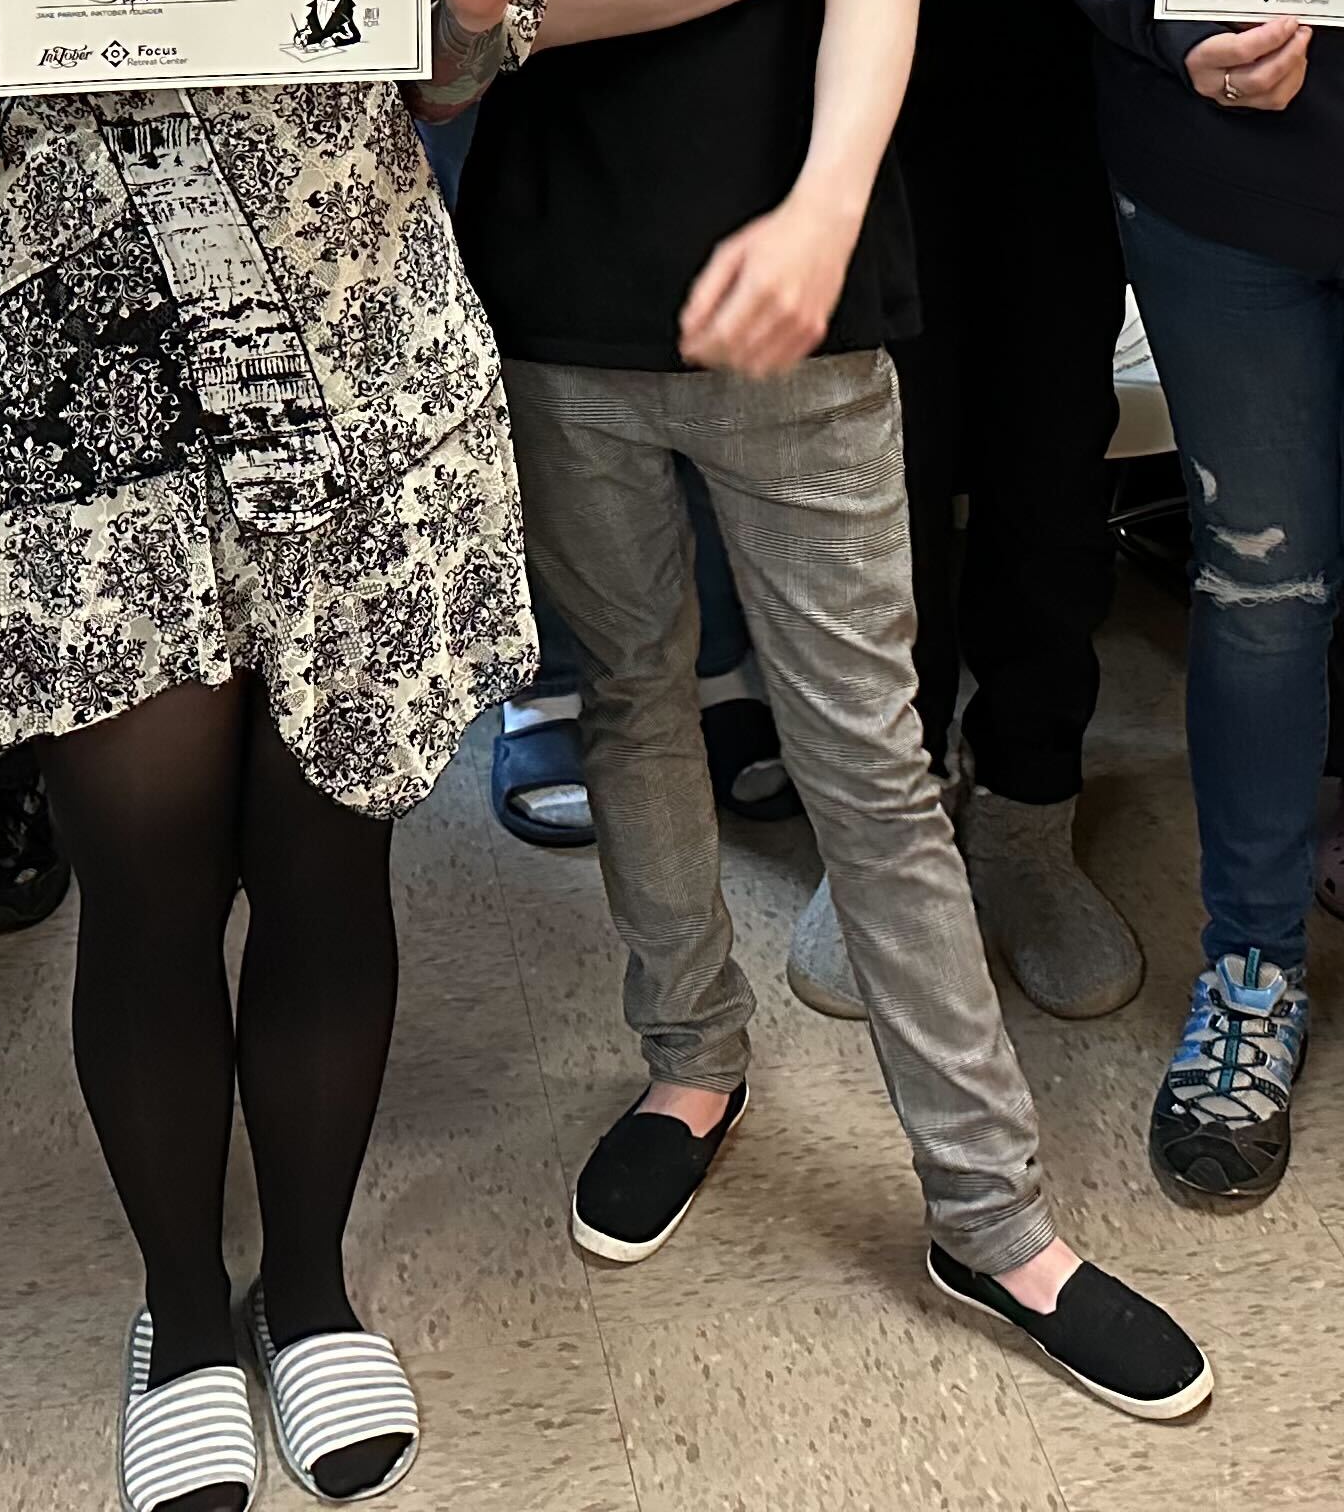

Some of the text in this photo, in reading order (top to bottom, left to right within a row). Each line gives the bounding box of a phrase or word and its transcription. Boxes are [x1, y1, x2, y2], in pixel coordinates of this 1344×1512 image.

[37, 44, 95, 69] InkTober
[138, 45, 177, 57] Focus
[127, 56, 189, 67] Retreat Center
